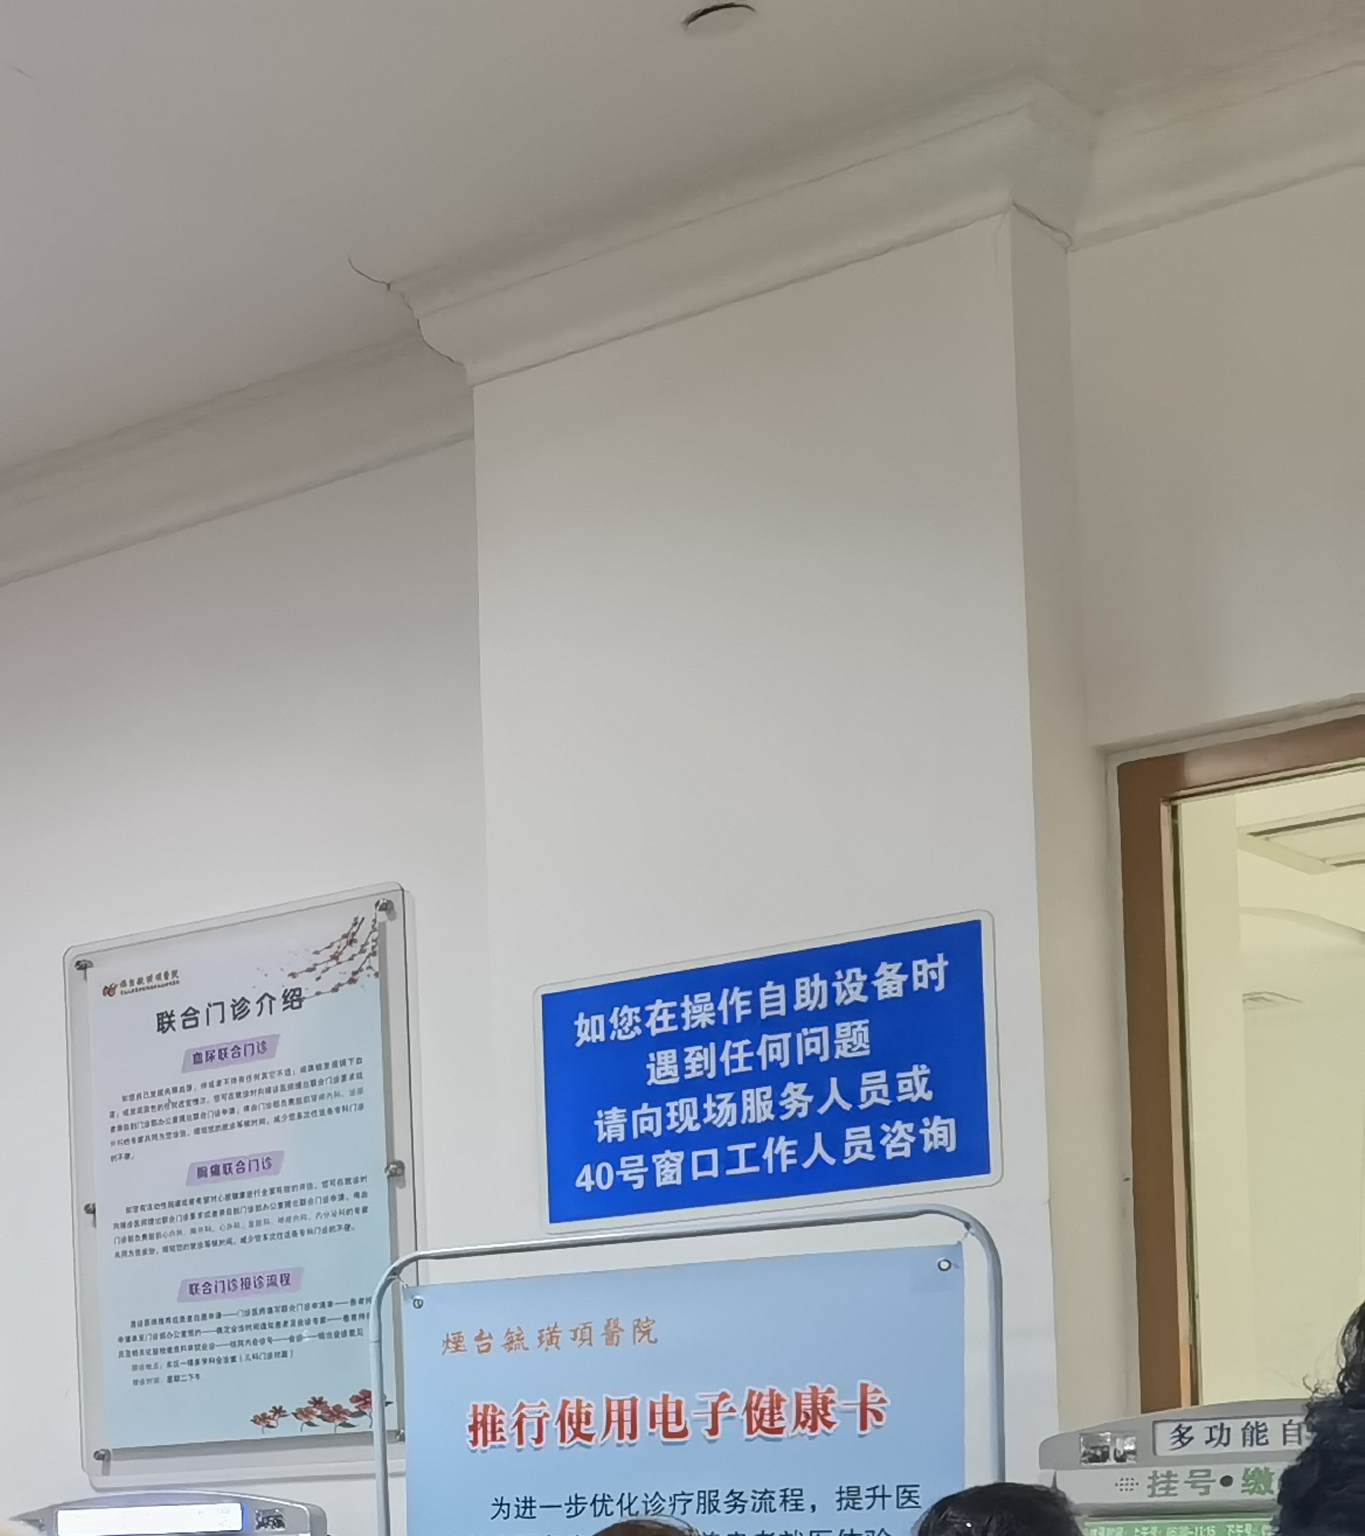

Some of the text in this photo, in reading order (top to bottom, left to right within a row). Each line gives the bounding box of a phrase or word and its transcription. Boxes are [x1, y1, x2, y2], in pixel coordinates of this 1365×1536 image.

[155, 986, 305, 1035] 联合门诊介绍
[573, 953, 950, 1048] 如您在操作自助设备时
[645, 1019, 871, 1087] 遇到任何问题
[594, 1064, 934, 1144] 请向现场服务人员或
[575, 1115, 957, 1193] 40号窗口工作人员咨询
[466, 1381, 891, 1451] 推行使用电子健康卡
[490, 1484, 922, 1520] 为进一步优化诊疗服务流程，提升医
